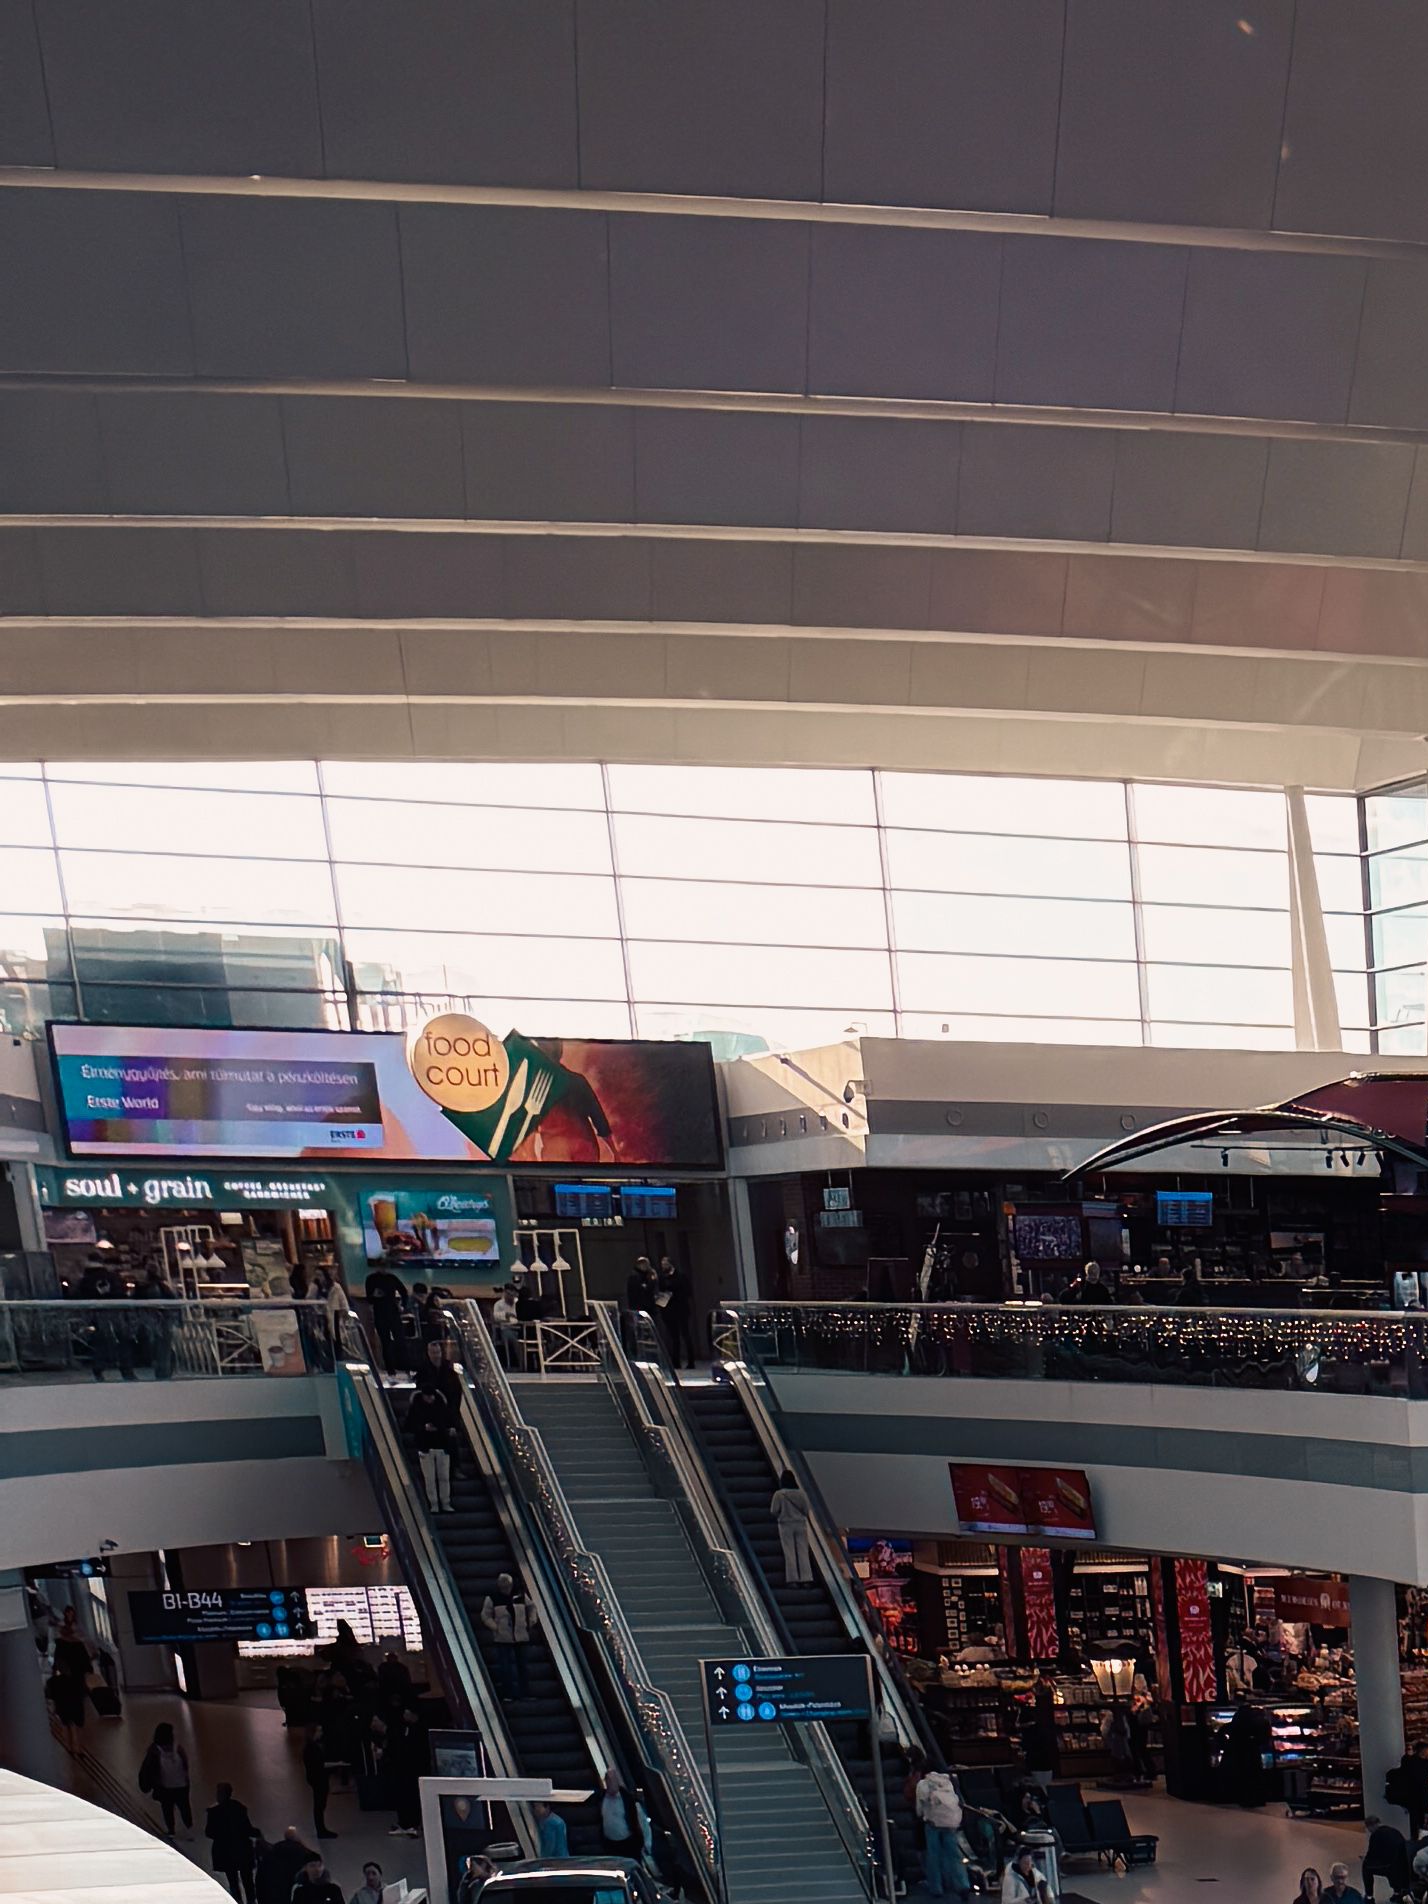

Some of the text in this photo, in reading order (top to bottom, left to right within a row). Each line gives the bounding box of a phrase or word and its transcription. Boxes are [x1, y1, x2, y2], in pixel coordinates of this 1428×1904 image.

[425, 1031, 491, 1057] food
[426, 1063, 500, 1087] court
[87, 1094, 159, 1109] Erste World
[65, 1173, 123, 1198] soul
[144, 1176, 213, 1205] grain
[162, 1591, 223, 1611] B1-B44
